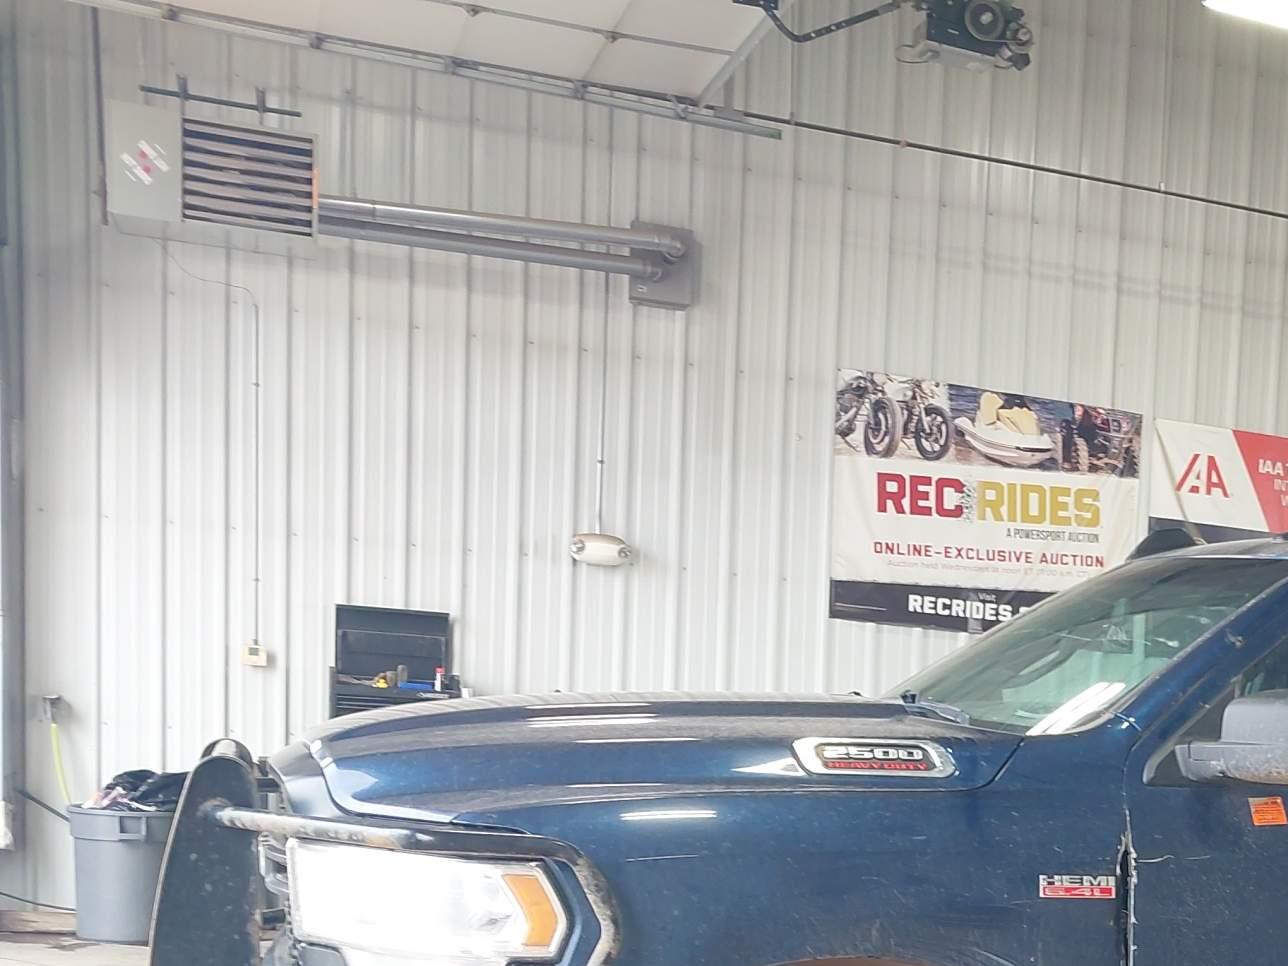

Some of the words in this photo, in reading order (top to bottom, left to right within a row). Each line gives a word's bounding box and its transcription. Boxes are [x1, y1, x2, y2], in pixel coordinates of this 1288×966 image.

[1258, 459, 1284, 477] IAA
[876, 472, 964, 519] REC
[976, 480, 1101, 528] RIDES
[873, 541, 1034, 563] ONLINE-EXCLUSIVE
[1039, 553, 1104, 568] AUCTION
[823, 746, 924, 760] 2500
[1039, 874, 1116, 886] HEMI
